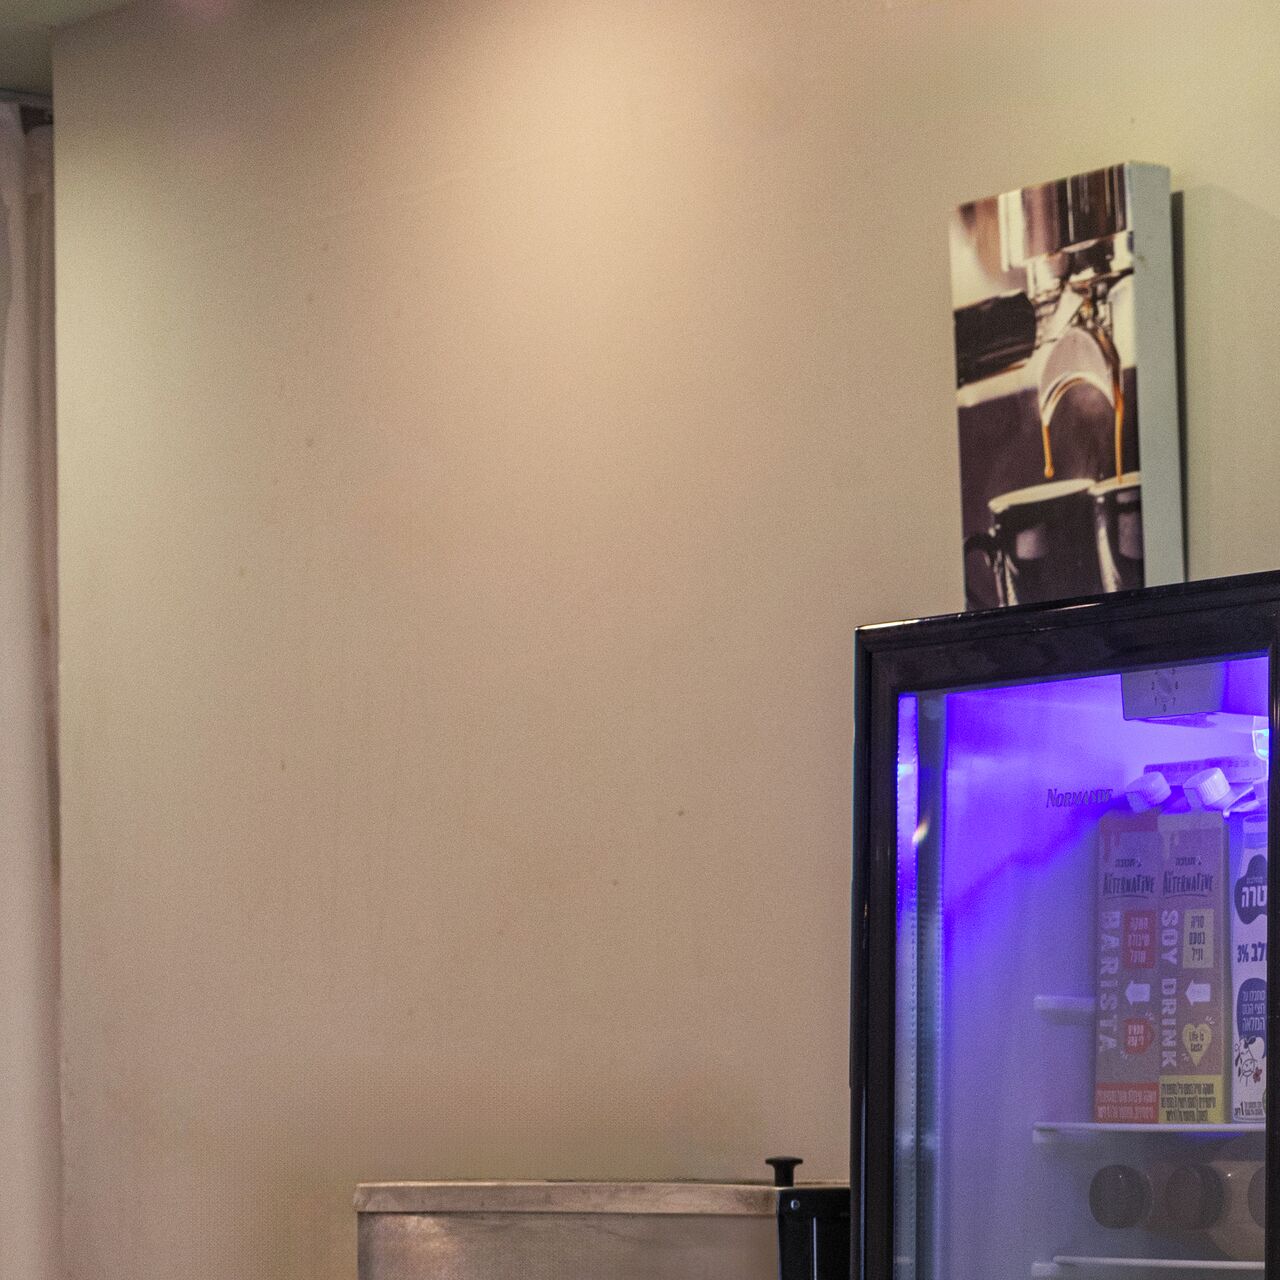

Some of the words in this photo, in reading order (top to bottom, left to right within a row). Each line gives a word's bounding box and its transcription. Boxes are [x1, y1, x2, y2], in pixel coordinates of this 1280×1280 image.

[1161, 910, 1179, 965] SOY
[1251, 941, 1267, 963] לב
[1099, 911, 1121, 1052] BARISTA
[1162, 978, 1177, 1068] DRINK
